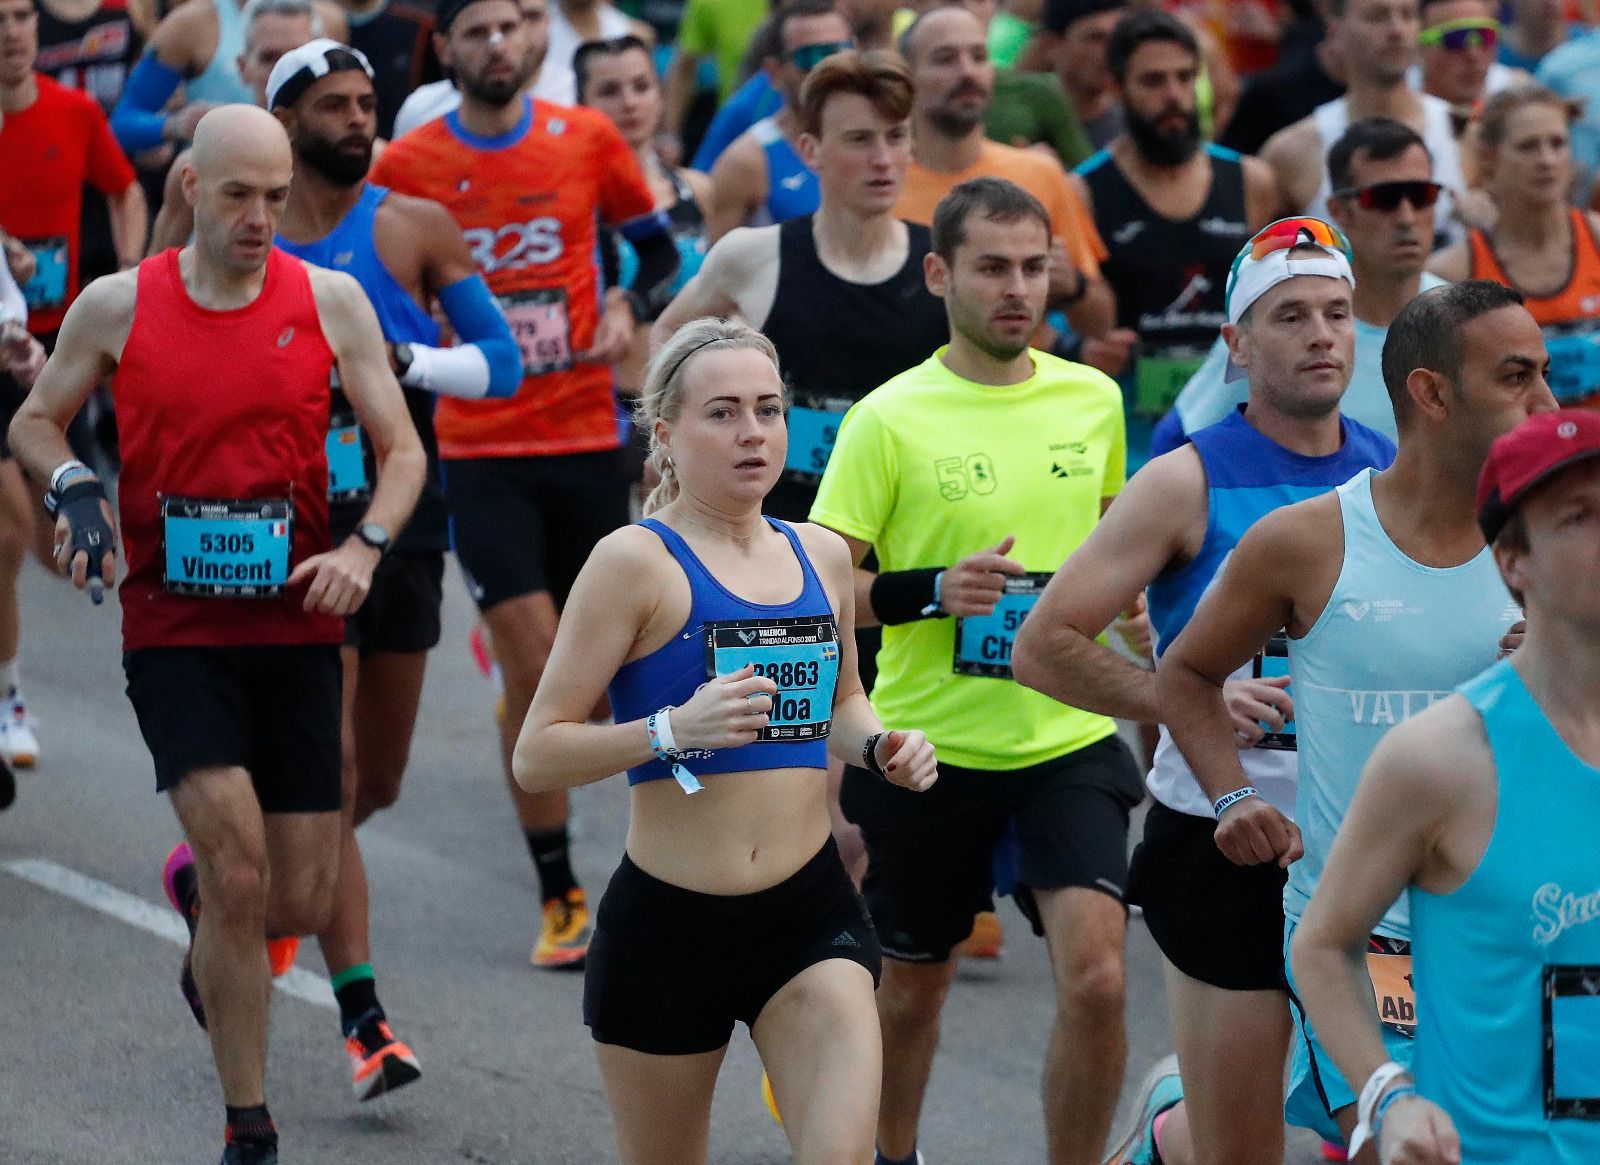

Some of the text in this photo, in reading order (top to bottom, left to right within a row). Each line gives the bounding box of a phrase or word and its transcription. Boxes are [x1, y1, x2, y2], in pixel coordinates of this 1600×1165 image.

[200, 533, 254, 554] 5305
[182, 556, 272, 581] Vincent
[759, 629, 787, 637] VALENCIA
[759, 637, 781, 646] TRINIDAD
[781, 635, 804, 644] ALFONSO
